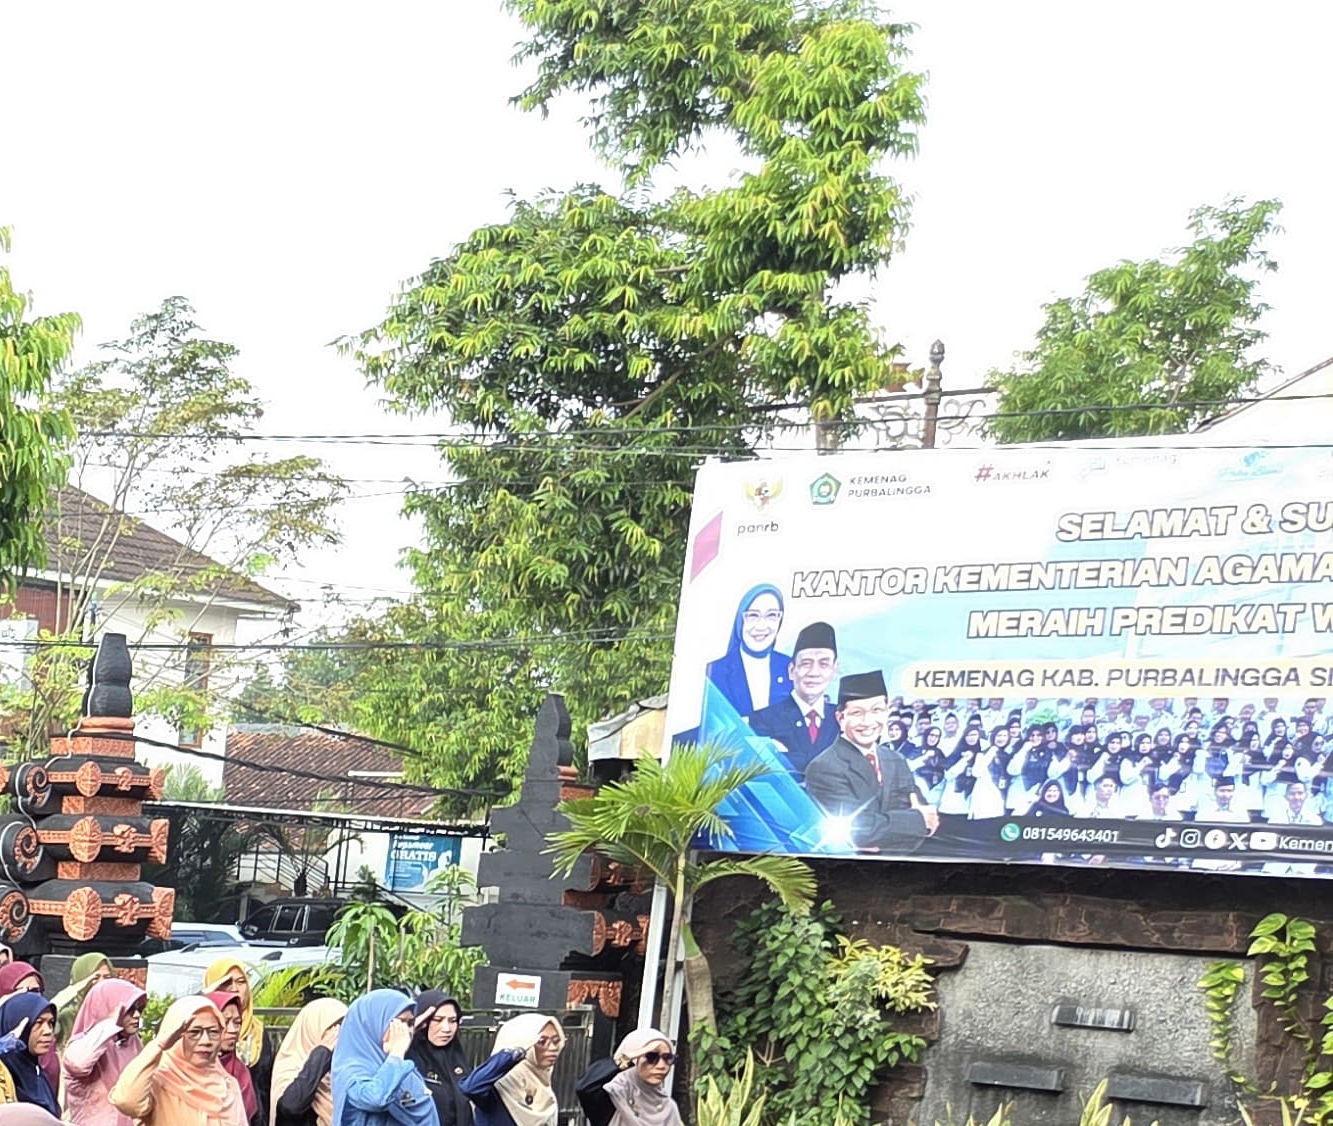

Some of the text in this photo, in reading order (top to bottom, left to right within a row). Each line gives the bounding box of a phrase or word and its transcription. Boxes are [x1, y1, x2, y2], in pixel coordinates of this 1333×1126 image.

[849, 474, 907, 485] KEMENAG
[974, 464, 1050, 482] #AKHLAK
[847, 485, 932, 498] PURBALINGGA
[737, 521, 779, 536] panrb
[1056, 505, 1238, 542] SELAMAT
[1241, 503, 1273, 534] &
[792, 552, 1333, 598] KANTOR KEMENTERIAN AGAMA
[967, 608, 1106, 639] MERAIH
[1110, 603, 1306, 636] PREDIKAT
[914, 669, 1035, 688] KEMENAG
[1041, 669, 1099, 687] KAB.
[1106, 668, 1301, 687] PURBALINGGA
[1023, 827, 1119, 844] 081549643401
[1279, 836, 1333, 852] Kemen
[500, 993, 536, 1003] KELUAR
